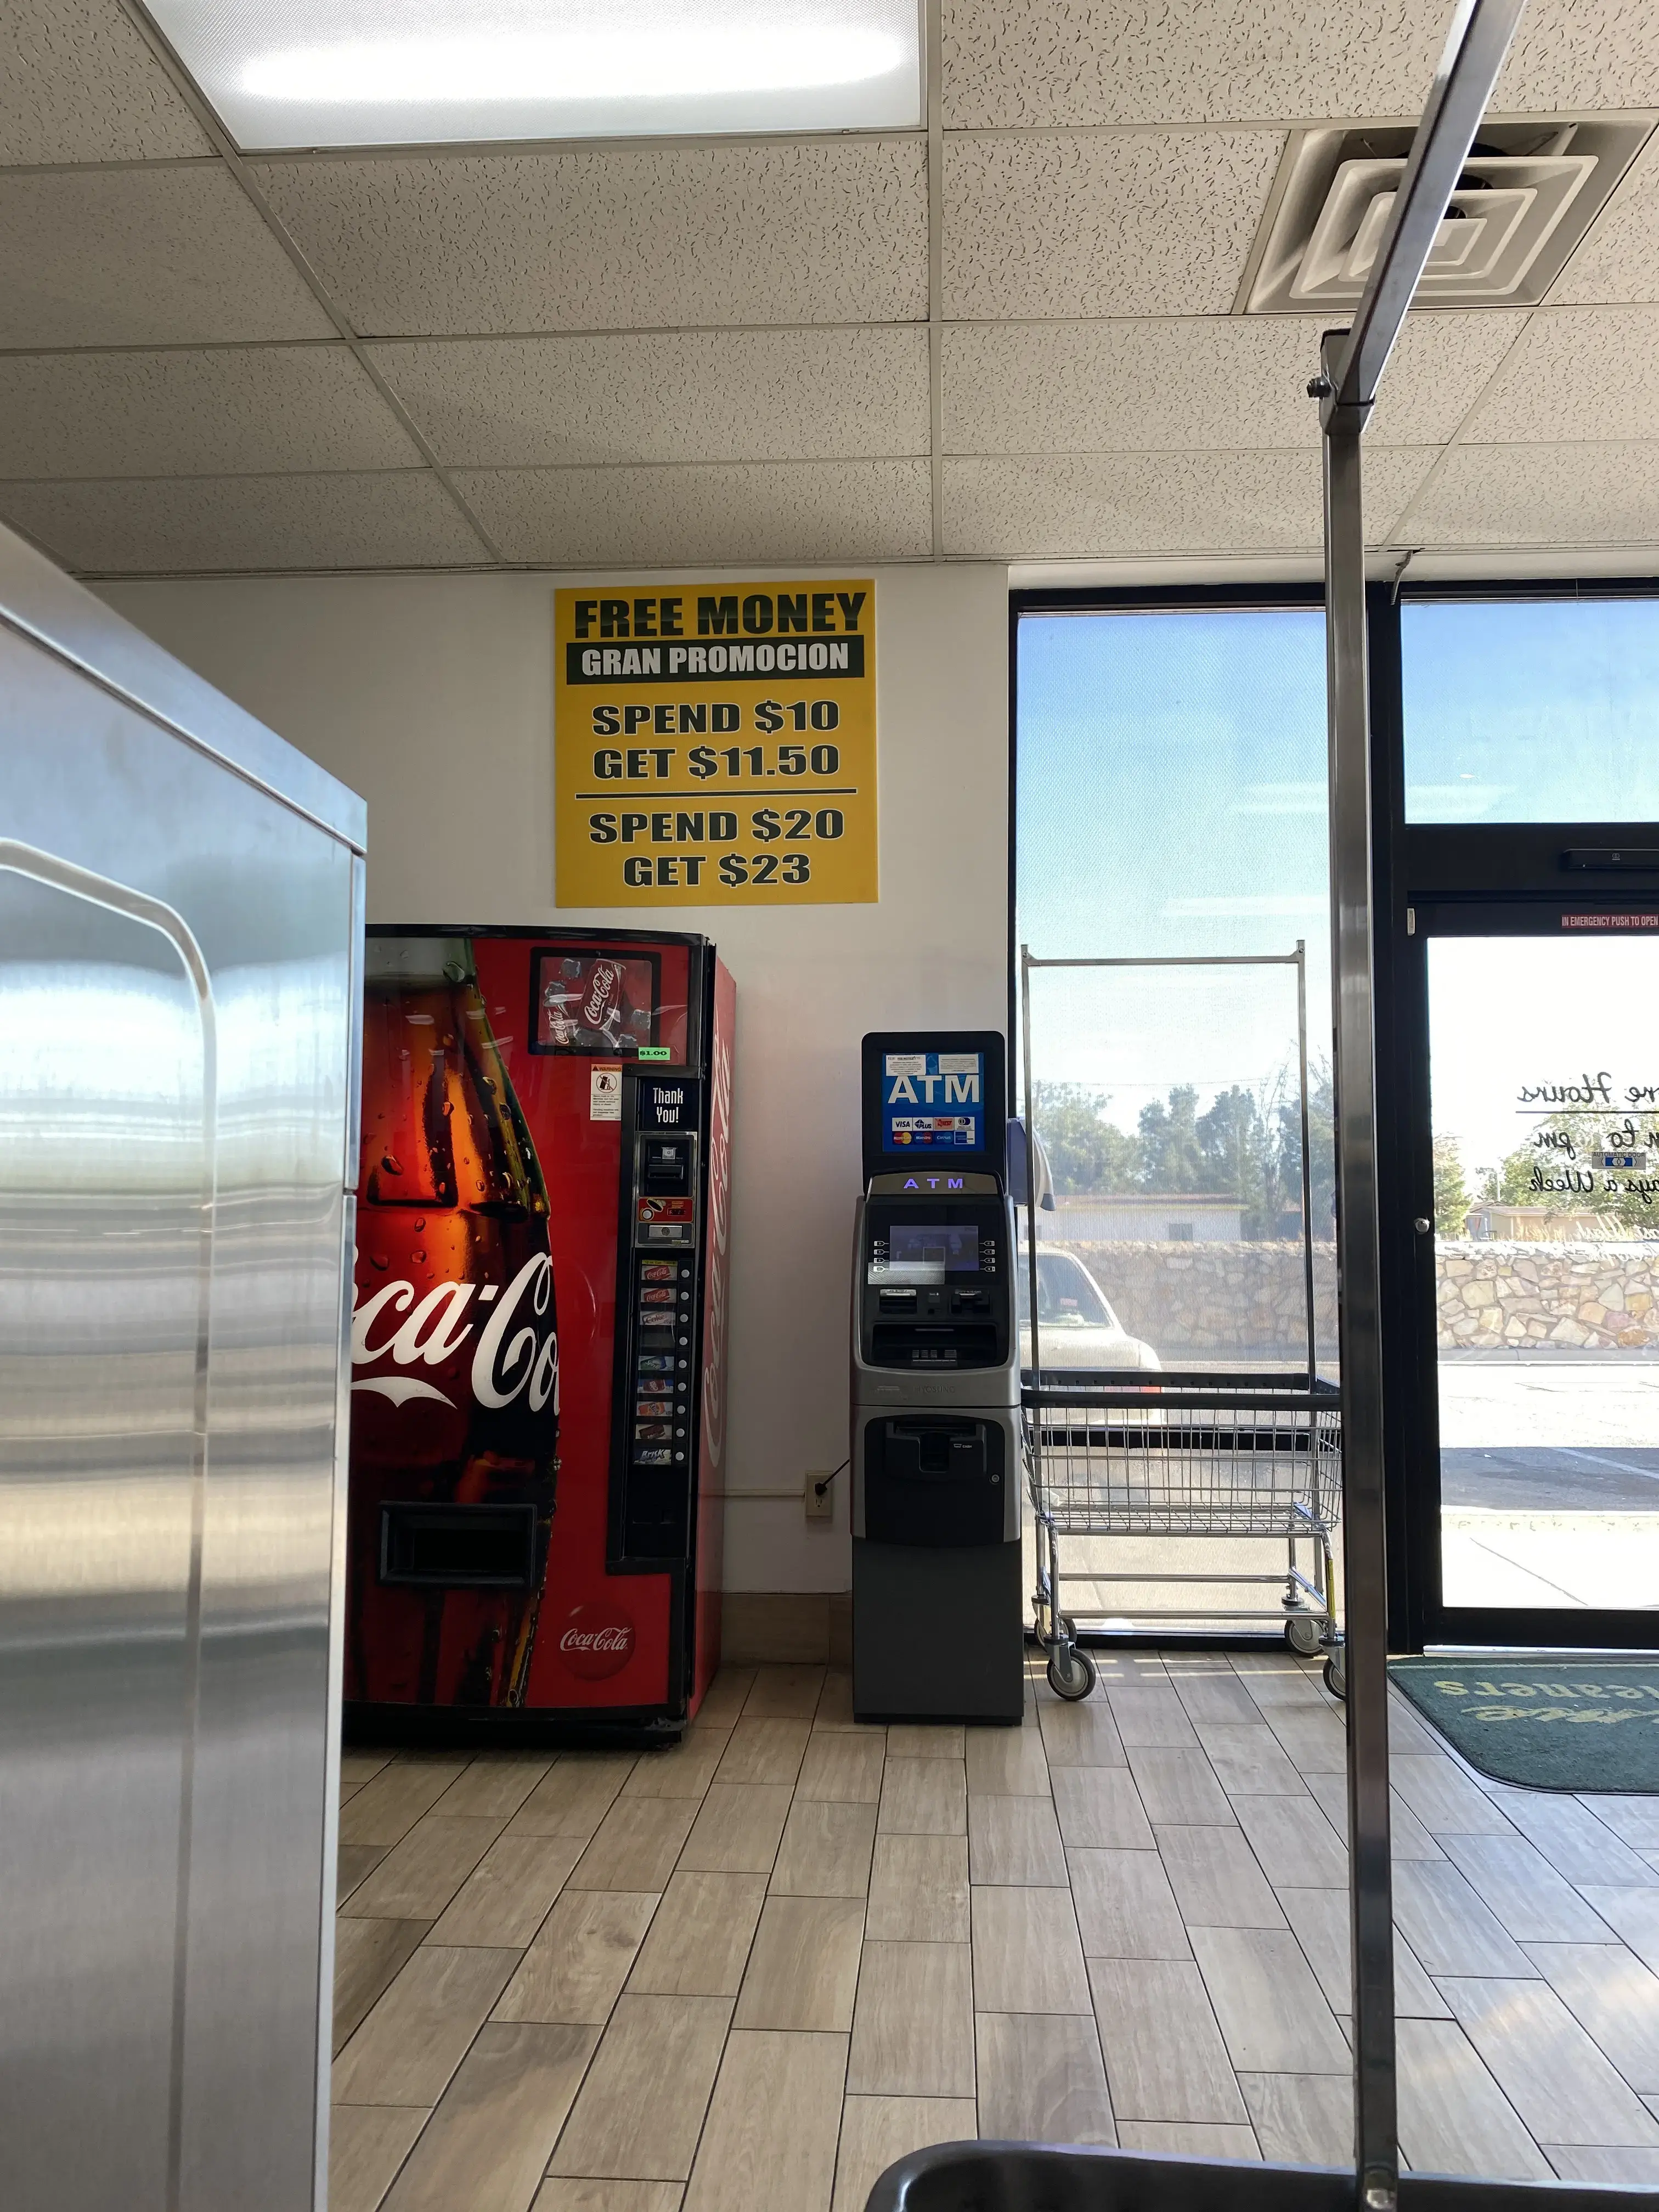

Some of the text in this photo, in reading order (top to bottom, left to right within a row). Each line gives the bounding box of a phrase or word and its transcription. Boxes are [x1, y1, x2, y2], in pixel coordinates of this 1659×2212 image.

[575, 592, 867, 638] FREE MONEY
[582, 643, 848, 675] GRAN PROMOCION
[592, 700, 840, 736] SPEND $10
[593, 744, 840, 781] GET $11.50
[589, 808, 844, 844] SPEND $20
[623, 853, 811, 888] GET $23
[1562, 916, 1658, 926] IN EMERGENCY PUSH TO OPEN
[653, 1087, 683, 1104] Thank
[888, 1075, 979, 1104] ATM
[656, 1107, 679, 1123] You!
[903, 1177, 963, 1189] ATM
[560, 1627, 633, 1651] Coca-Cola
[1433, 1680, 1659, 1700] leaners
